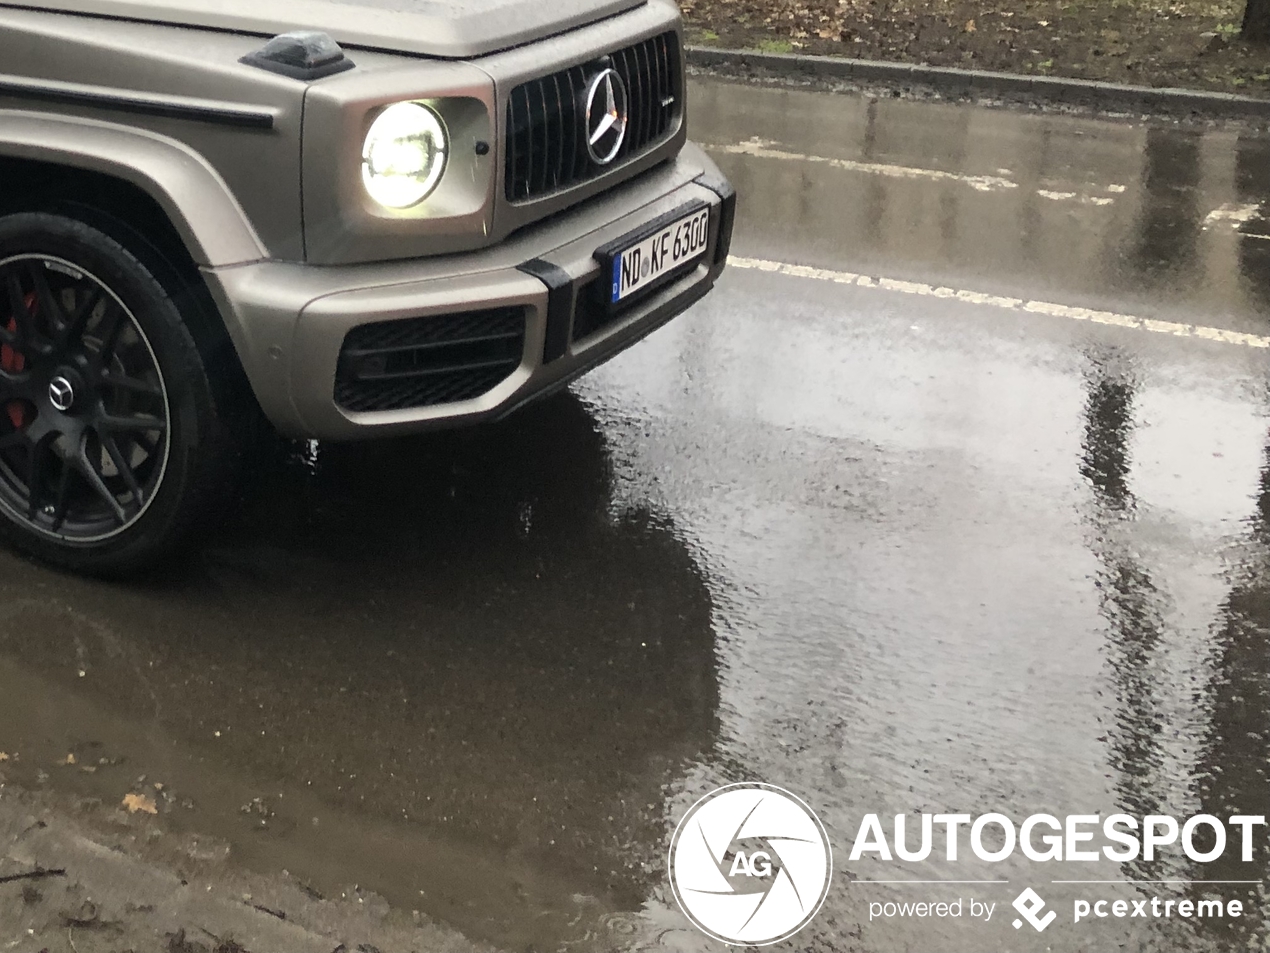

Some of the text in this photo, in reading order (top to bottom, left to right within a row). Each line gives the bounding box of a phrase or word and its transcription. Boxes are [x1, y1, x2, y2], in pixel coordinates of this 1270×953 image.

[621, 213, 708, 291] ND KF 6300
